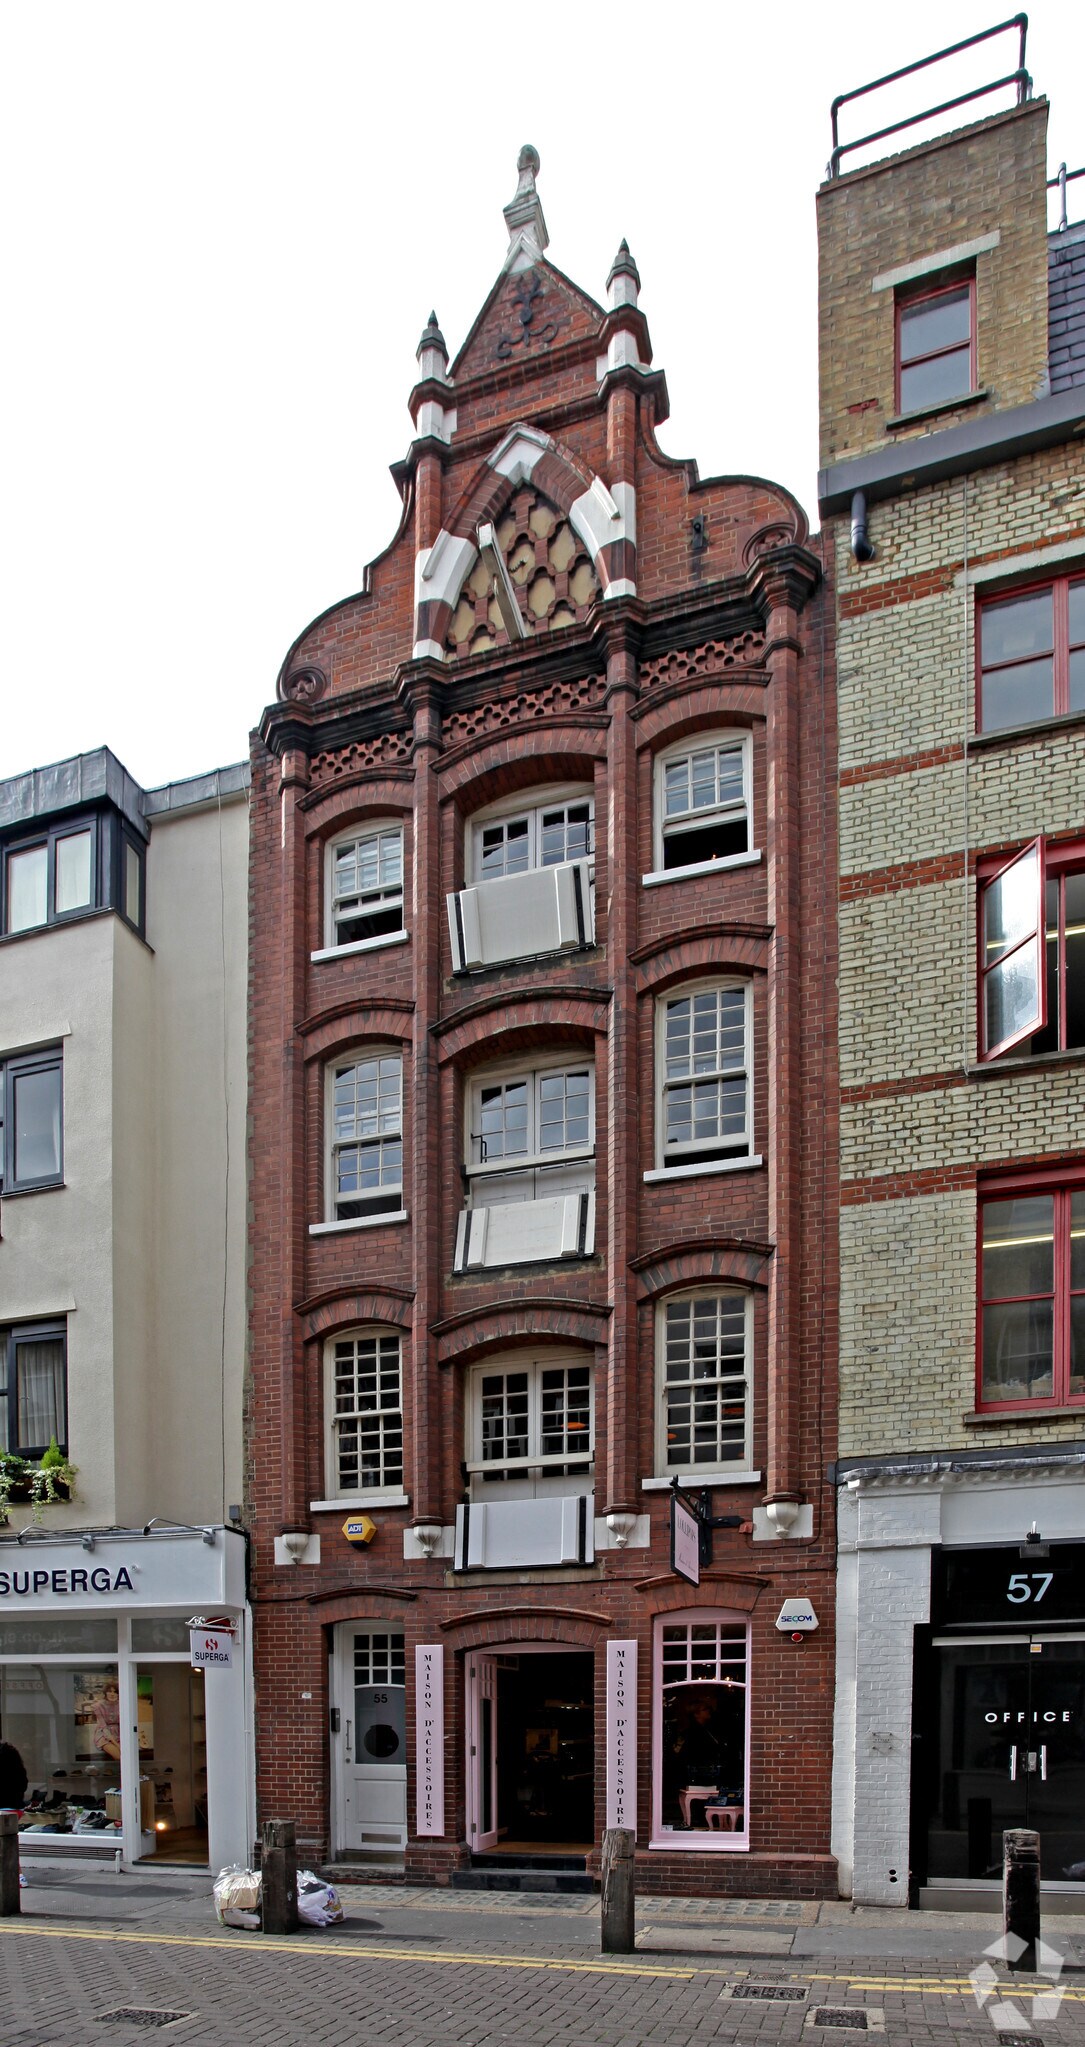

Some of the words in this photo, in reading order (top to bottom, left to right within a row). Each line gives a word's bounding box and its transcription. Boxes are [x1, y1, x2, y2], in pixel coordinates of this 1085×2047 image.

[348, 1525, 363, 1533] ADT
[0, 1567, 134, 1595] SUPERGA
[1006, 1573, 1054, 1604] 57
[781, 1615, 812, 1623] SECOM
[194, 1651, 230, 1662] SUPERGA
[424, 1654, 432, 1709] MAISON
[616, 1650, 626, 1708] MAISON
[373, 1693, 388, 1704] 55
[984, 1711, 1071, 1723] OFFICE
[424, 1719, 435, 1829] D'ACCESSOIRES
[616, 1719, 628, 1828] D'ACCESSOIRE
